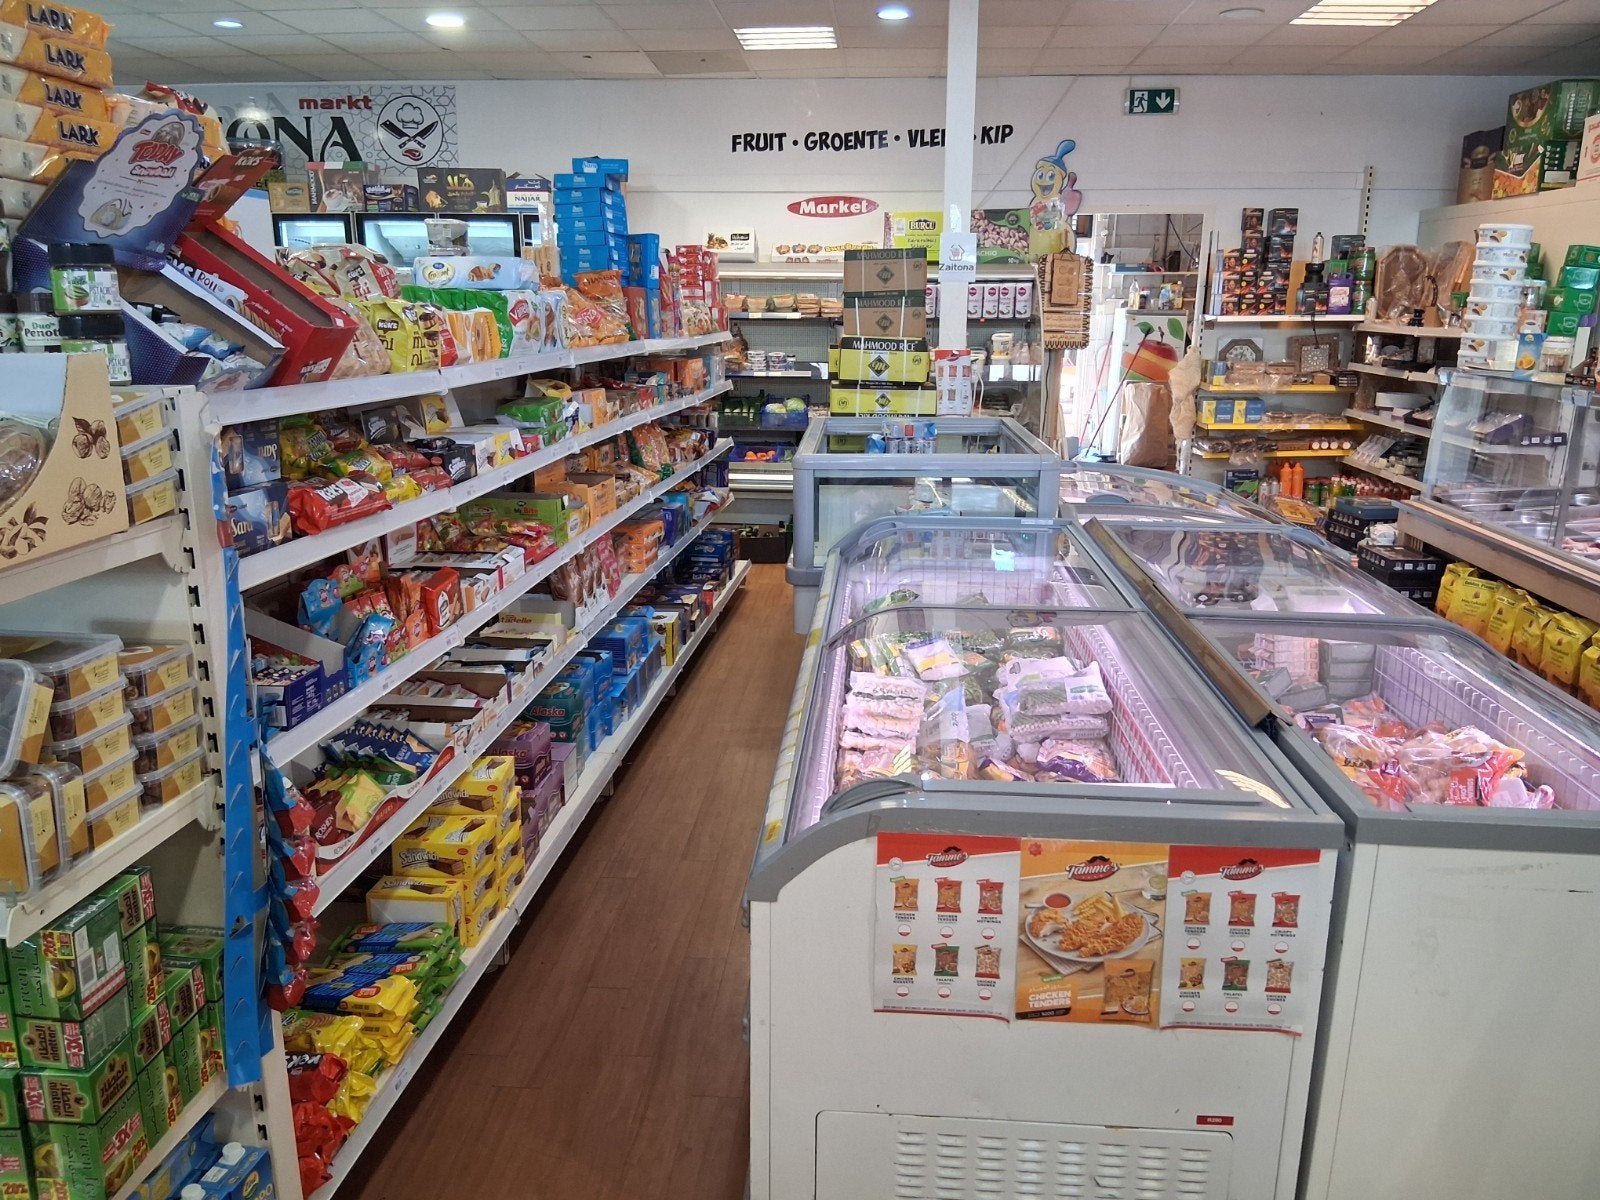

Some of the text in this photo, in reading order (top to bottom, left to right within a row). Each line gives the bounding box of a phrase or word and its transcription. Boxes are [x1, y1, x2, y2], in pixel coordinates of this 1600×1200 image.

[26, 3, 73, 34] LARK
[45, 43, 86, 73] LARK
[44, 83, 82, 110] LARK
[298, 96, 373, 110] markt
[58, 119, 101, 147] LARK
[219, 116, 363, 162] ONA
[731, 125, 1014, 152] FRUIT GROENTE VLE KIP
[800, 200, 869, 215] Market
[858, 299, 896, 307] MAHMOOD
[32, 321, 51, 330] Duo
[853, 341, 897, 351] MAHMOOD
[229, 519, 253, 538] Sara
[531, 706, 566, 717] Alaska
[315, 814, 334, 839] ROSHEN
[400, 851, 439, 864] Sandwich
[1028, 998, 1071, 1008] TENDERS
[1029, 990, 1071, 1001] CHICKEN
